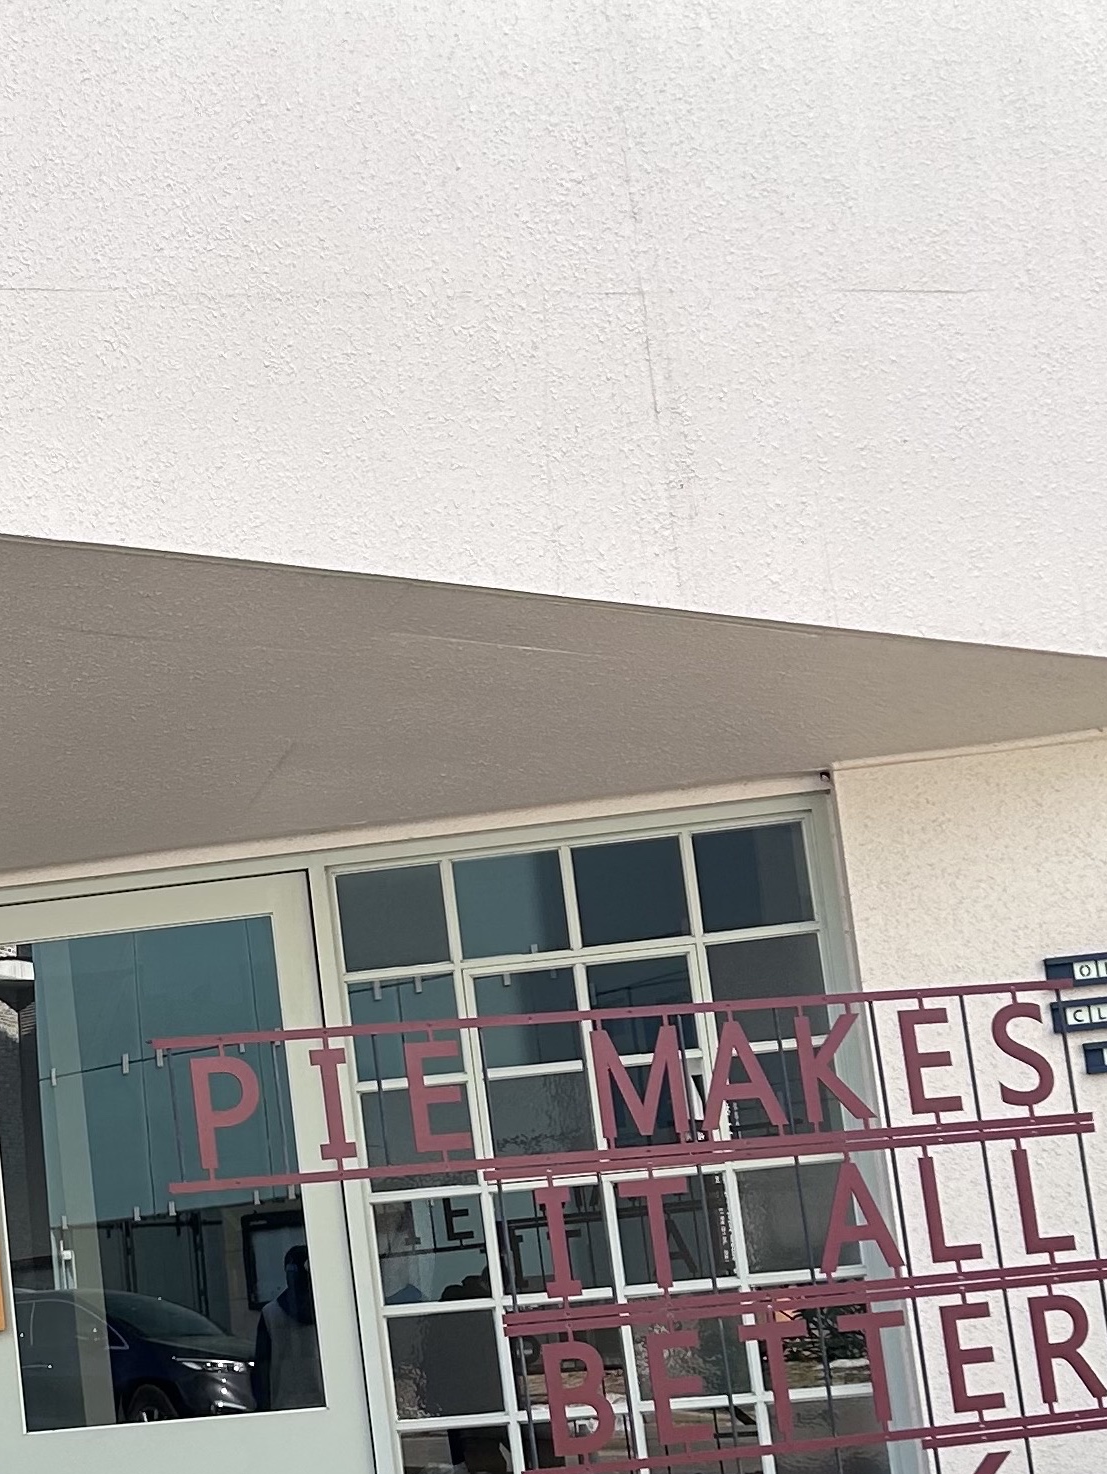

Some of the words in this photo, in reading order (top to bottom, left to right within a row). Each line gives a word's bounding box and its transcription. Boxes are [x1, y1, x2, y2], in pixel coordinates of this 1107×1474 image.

[190, 1040, 474, 1168] PIE
[590, 1003, 1055, 1138] MAKES
[535, 1178, 688, 1297] IT
[821, 1149, 1075, 1273] ALL
[542, 1296, 1107, 1457] BETTER
